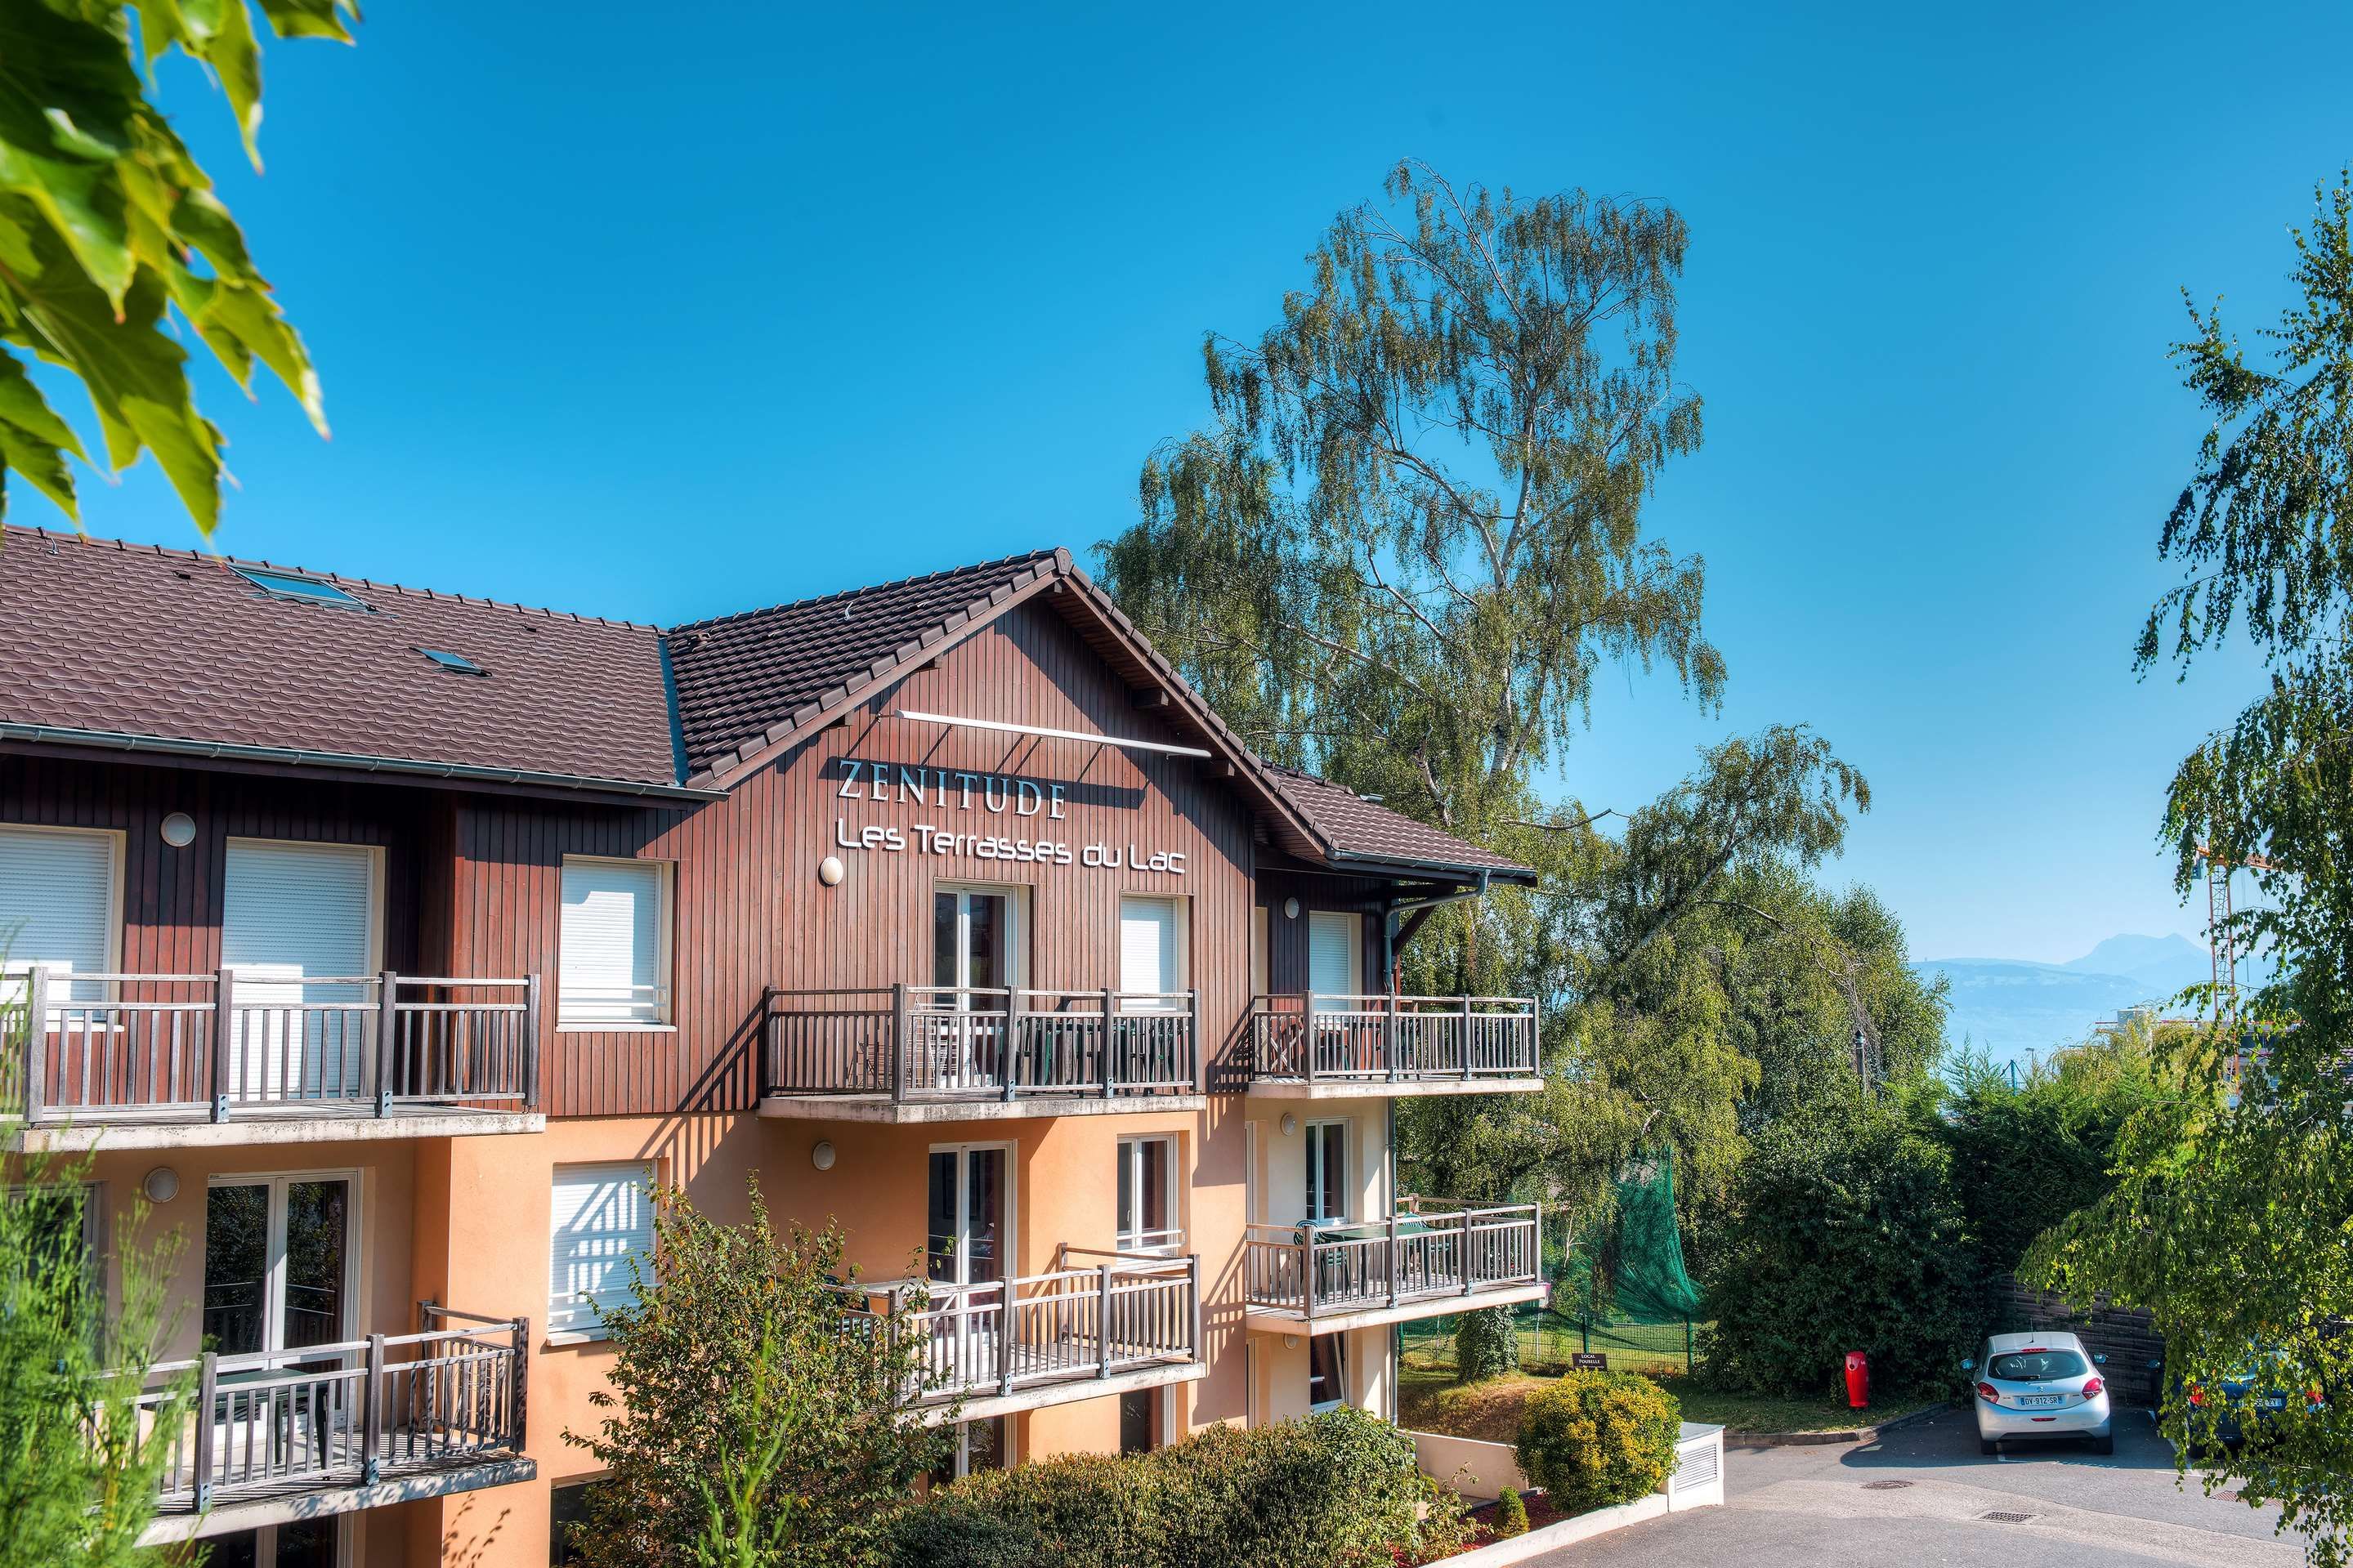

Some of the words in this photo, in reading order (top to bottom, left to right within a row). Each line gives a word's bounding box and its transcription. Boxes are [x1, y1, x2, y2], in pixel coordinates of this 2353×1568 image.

[837, 759, 1066, 820] ZENITUDE
[837, 818, 906, 851] Les
[914, 824, 1072, 864] Terrasses
[1083, 842, 1121, 868] du
[1130, 844, 1186, 873] Lac
